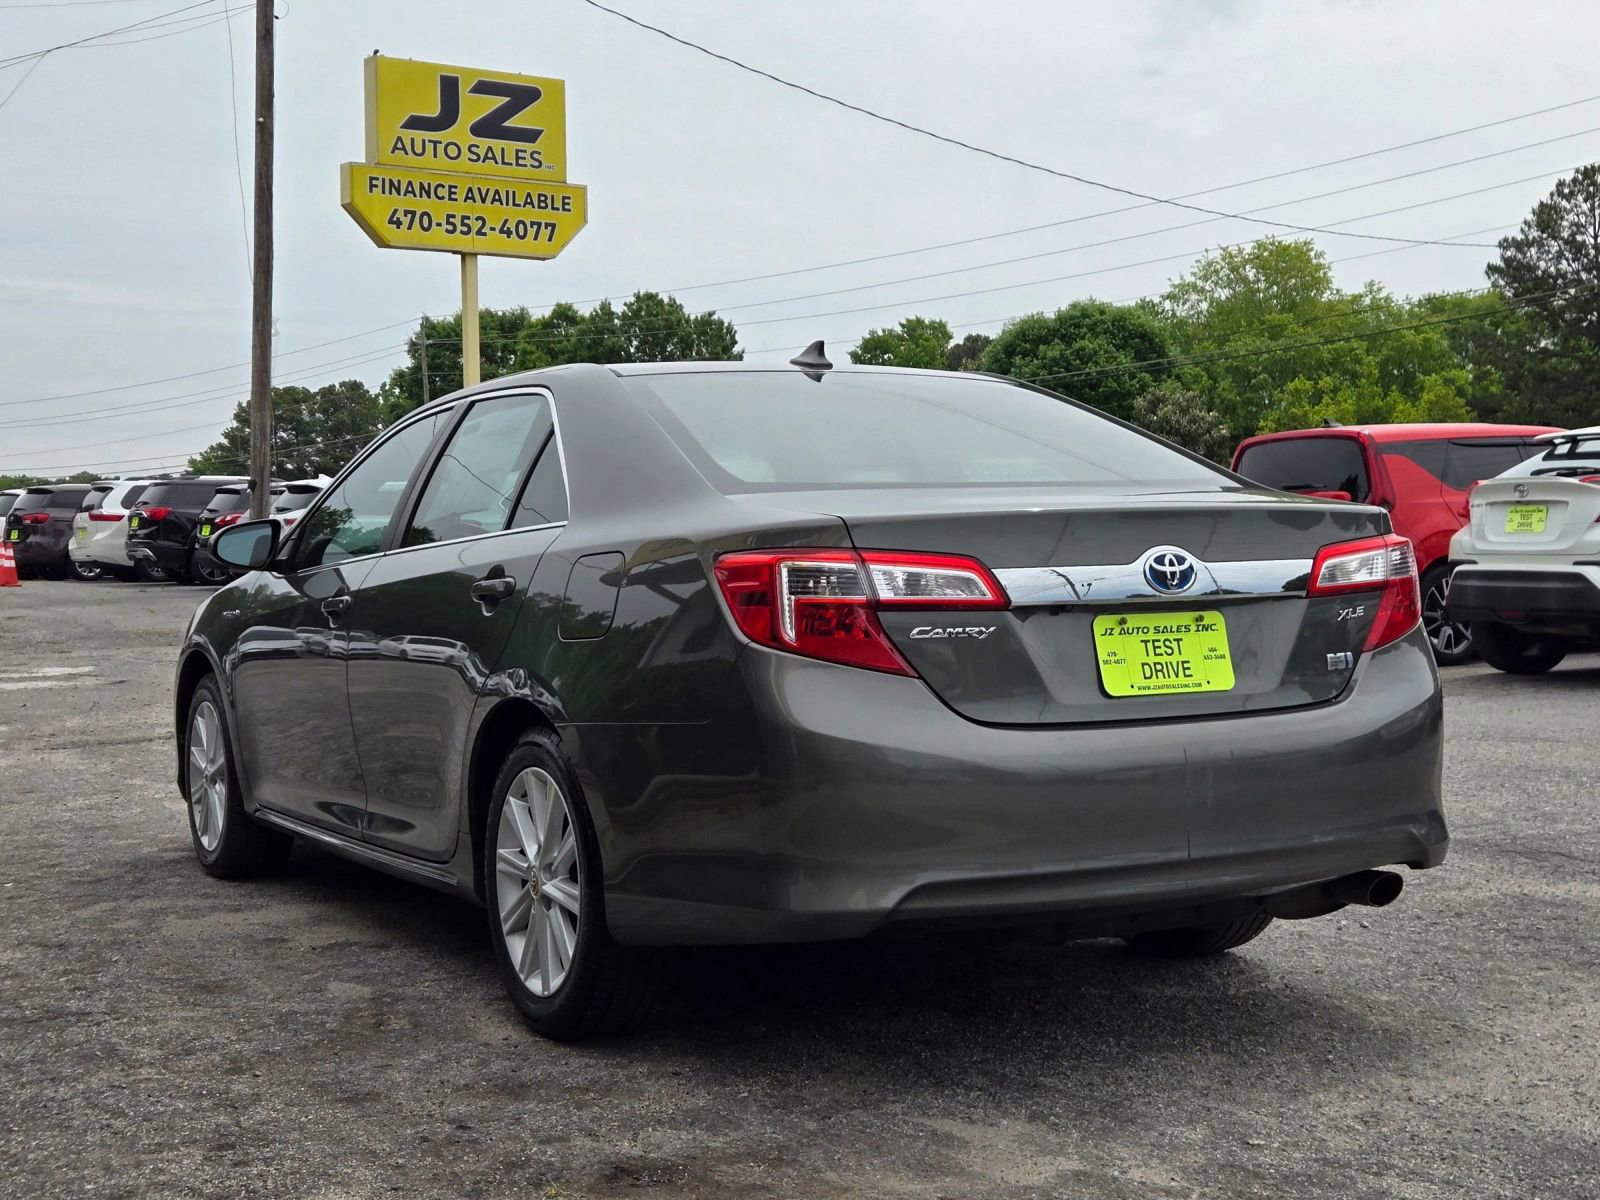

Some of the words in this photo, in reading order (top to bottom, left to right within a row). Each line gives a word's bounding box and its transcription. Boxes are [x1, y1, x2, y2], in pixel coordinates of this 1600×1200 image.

[399, 74, 545, 144] JZ
[390, 136, 462, 161] AUTO
[467, 143, 543, 169] SALES
[368, 175, 458, 202] FINANCE
[463, 186, 572, 212] AVAILABLE
[387, 208, 557, 242] 470-552-4077
[1337, 606, 1365, 621] XLE
[1100, 627, 1115, 637] JZ
[1118, 626, 1150, 636] AUTO
[1153, 624, 1191, 634] SALES
[1194, 623, 1219, 633] INC.
[1140, 638, 1184, 657] TEST
[1141, 660, 1193, 680] DRIVE
